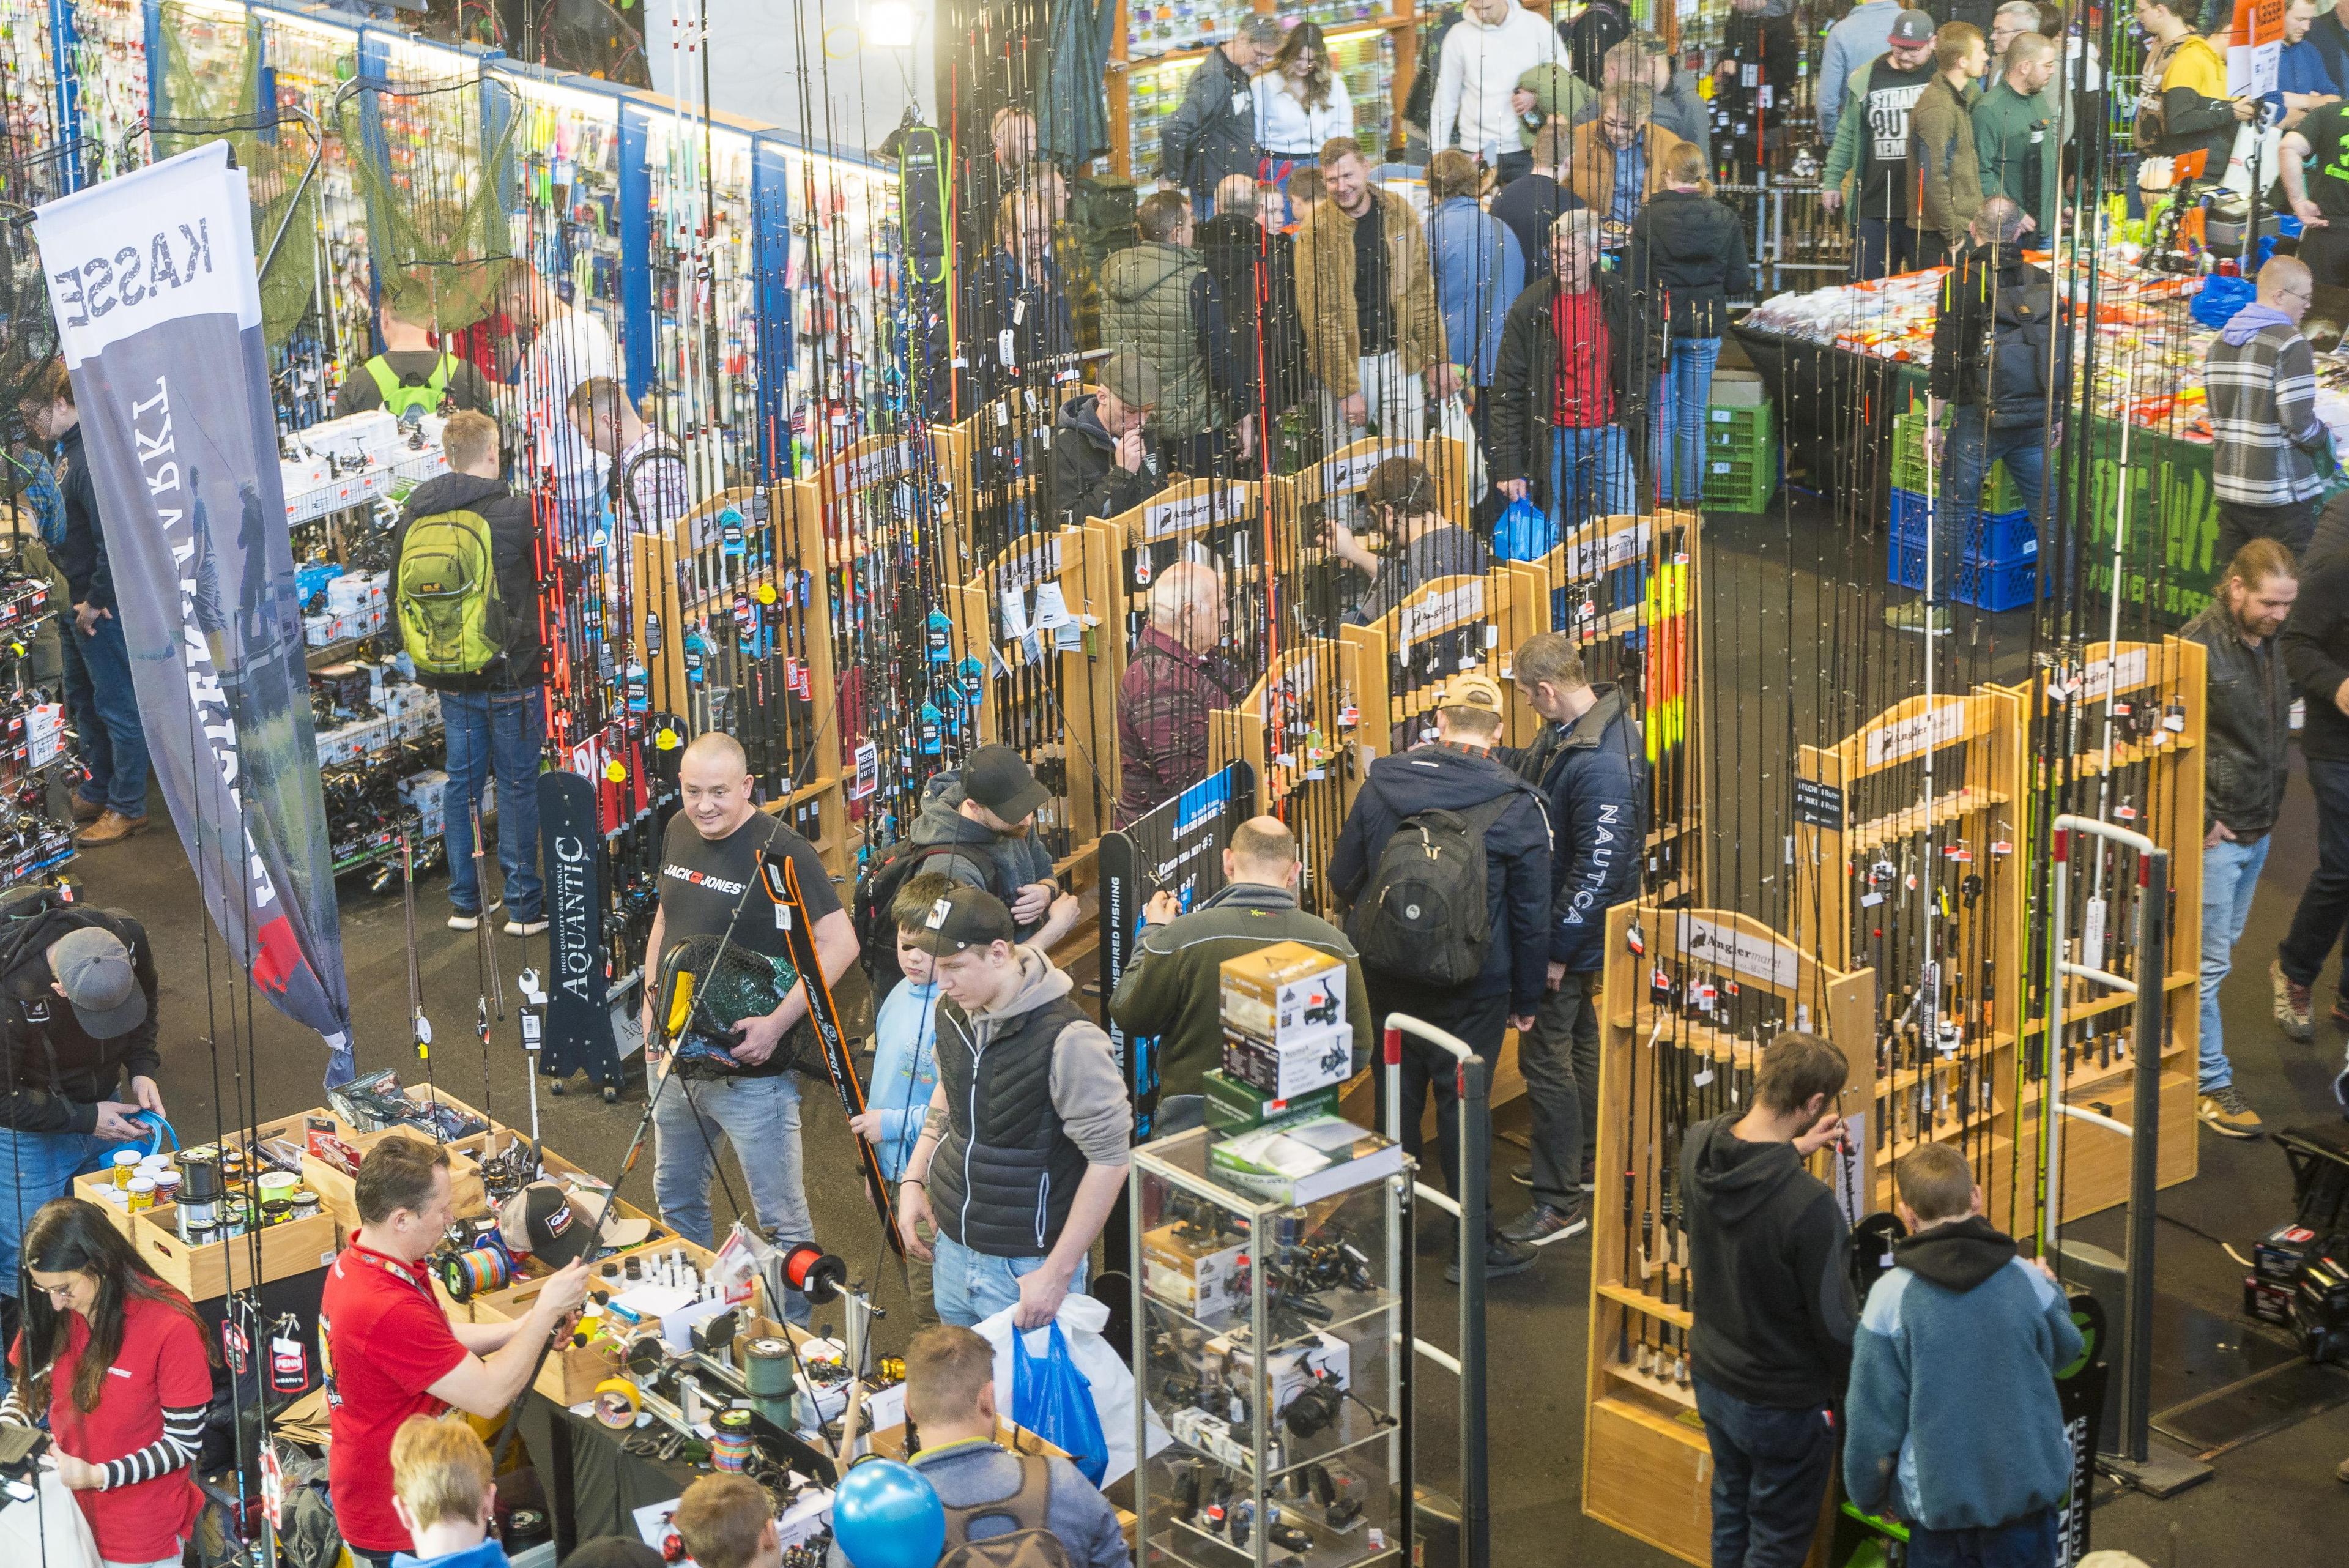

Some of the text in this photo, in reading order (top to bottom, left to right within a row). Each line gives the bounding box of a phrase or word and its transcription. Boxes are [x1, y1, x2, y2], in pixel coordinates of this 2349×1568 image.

[1027, 394, 1036, 409] BALZER
[859, 751, 874, 764] REISE
[860, 760, 874, 771] TRAVEL
[860, 767, 874, 779] RUTE
[1563, 804, 1619, 924] NAUTICA
[664, 864, 693, 882] JACK
[1111, 876, 1120, 925] FISHING
[555, 836, 592, 1003] AQUANTIC
[275, 1359, 301, 1369] PENN
[2071, 1415, 2087, 1561] ACKLE SYSTEM
